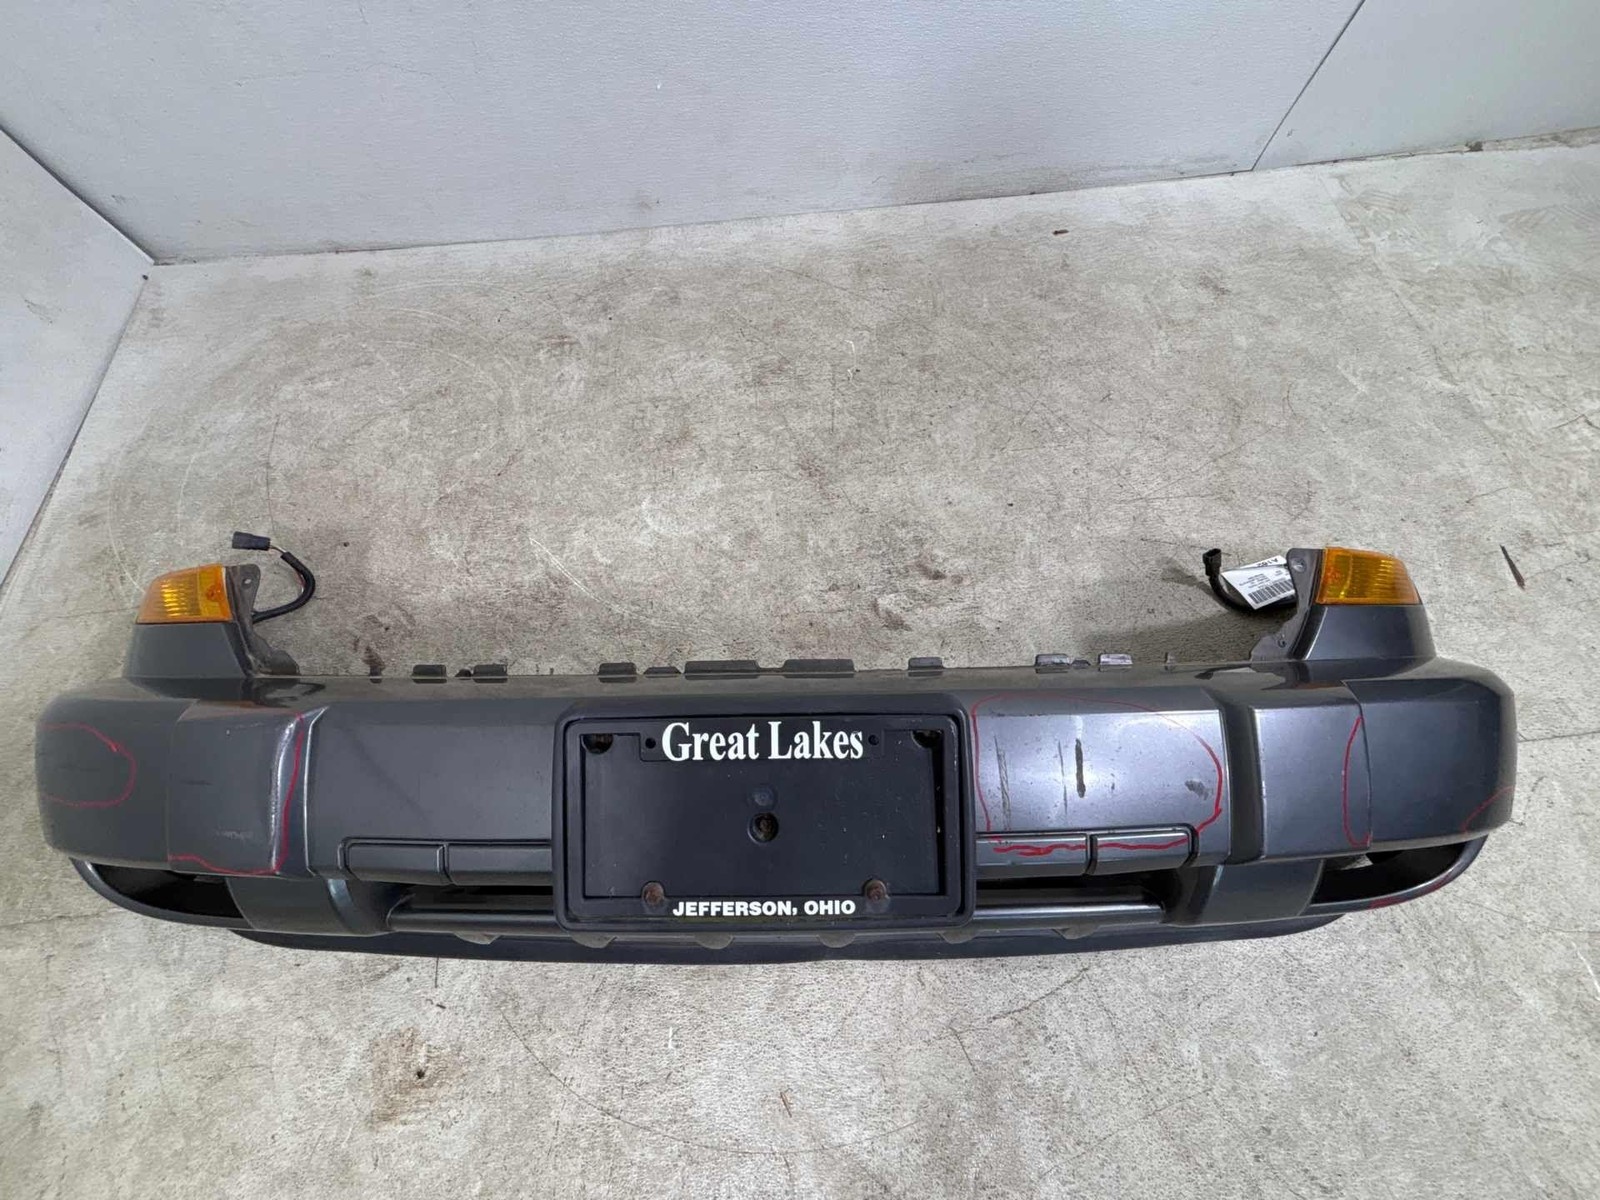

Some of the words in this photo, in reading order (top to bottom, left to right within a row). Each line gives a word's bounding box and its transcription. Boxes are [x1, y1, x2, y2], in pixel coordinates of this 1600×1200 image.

[661, 721, 760, 761] Great
[767, 720, 864, 760] Lakes
[672, 900, 798, 917] JEFFERSON,
[803, 899, 856, 915] OHIO
